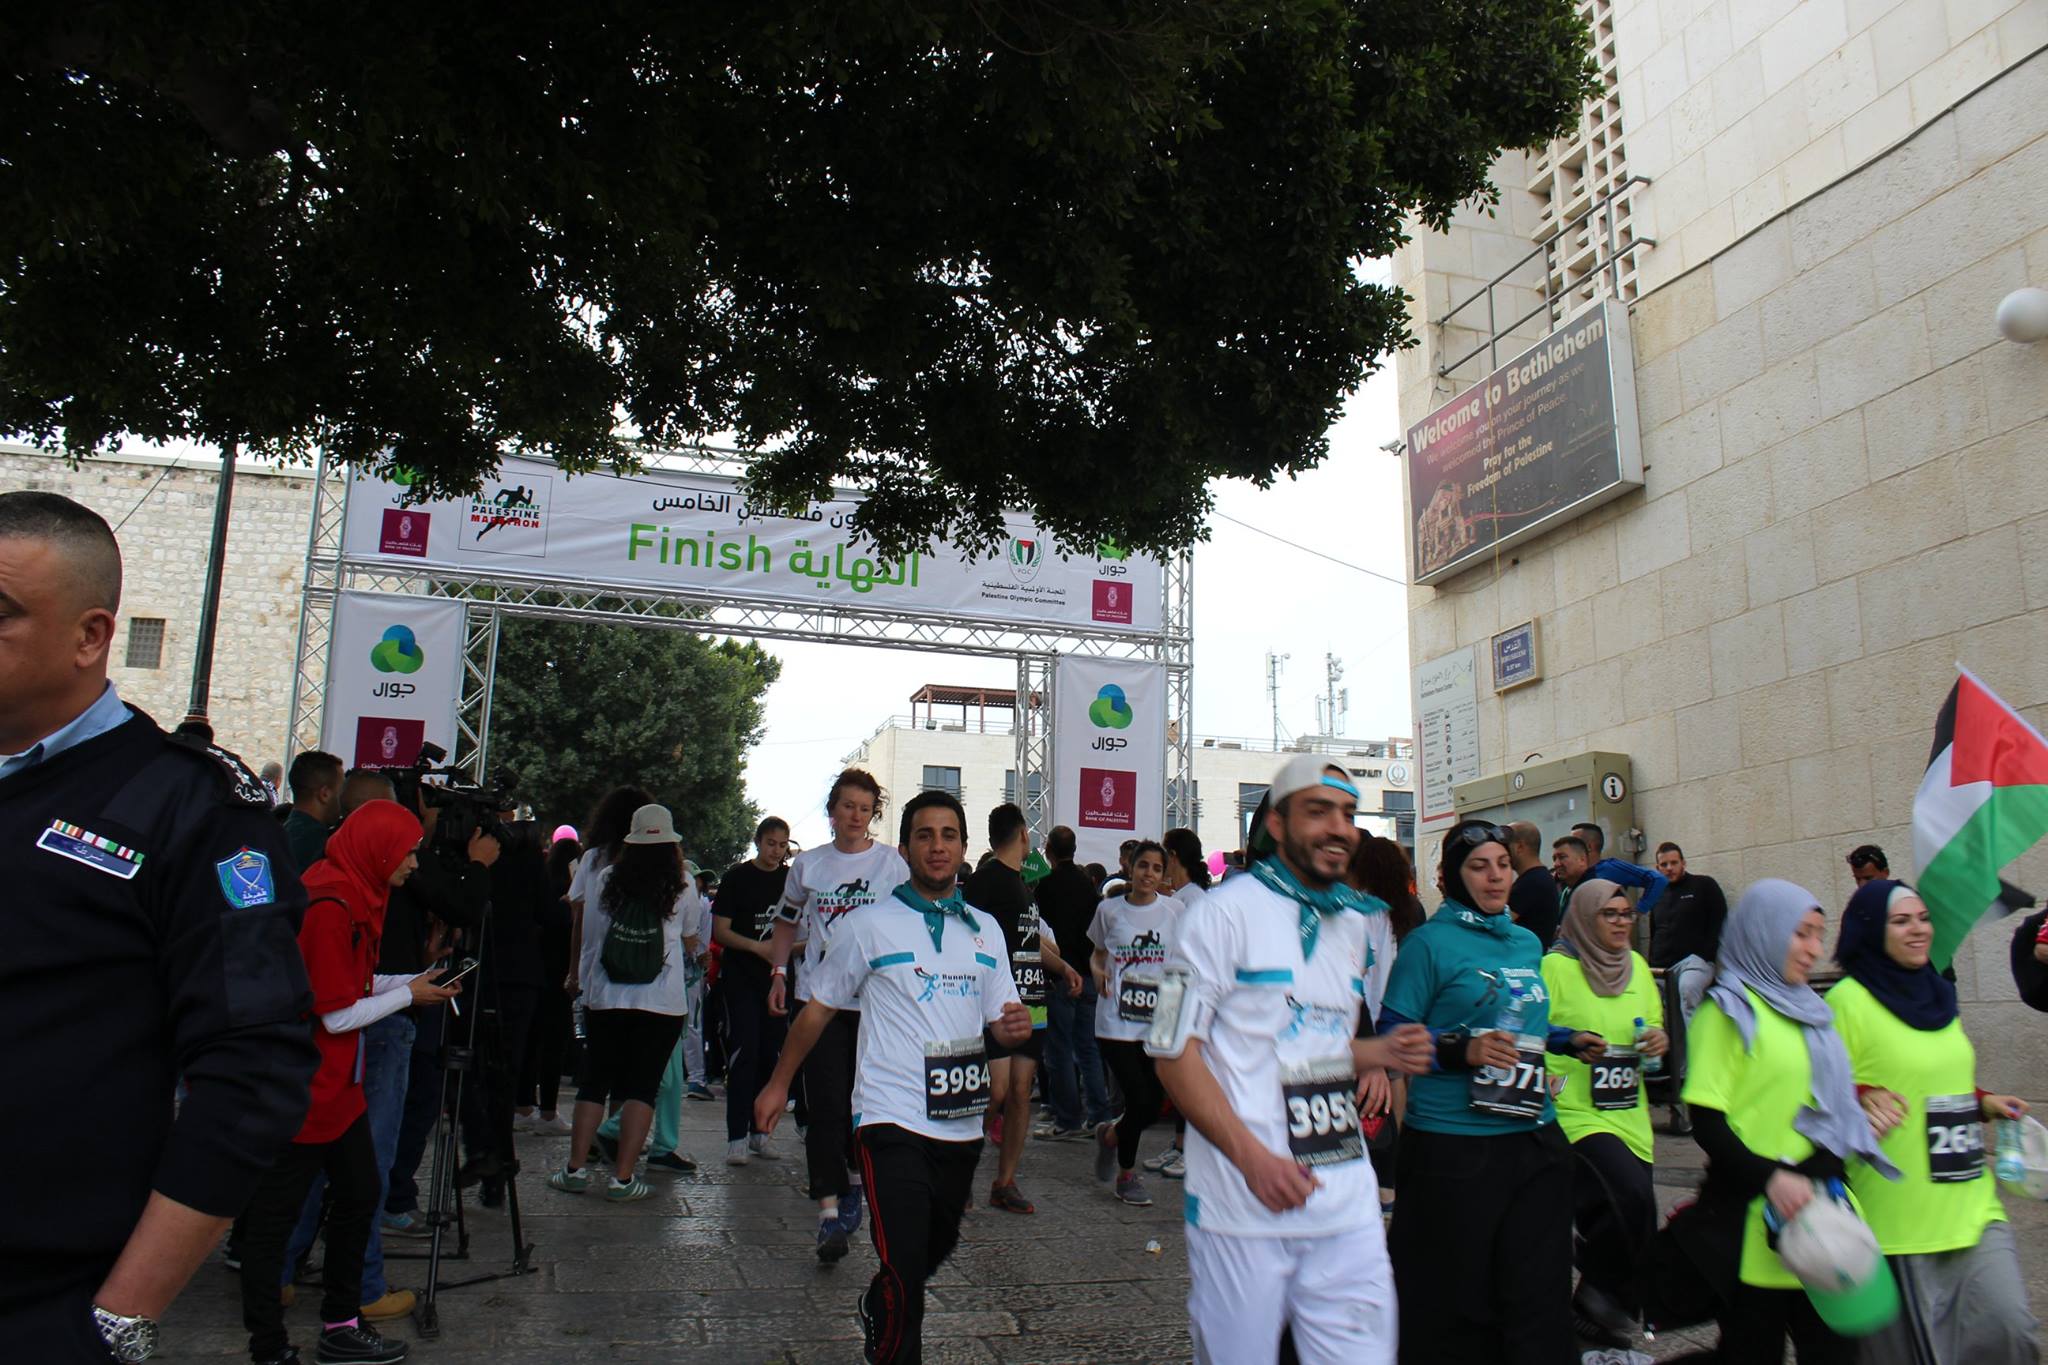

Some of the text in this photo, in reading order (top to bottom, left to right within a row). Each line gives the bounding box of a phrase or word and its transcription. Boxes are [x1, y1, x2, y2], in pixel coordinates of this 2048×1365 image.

[1412, 318, 1604, 454] Welcome to Bethlehem
[1503, 400, 1522, 423] your
[1523, 380, 1557, 410] journey
[1558, 371, 1570, 385] as
[1571, 362, 1585, 377] we
[1497, 417, 1525, 439] Prince
[1526, 408, 1536, 423] of
[1483, 435, 1532, 471] Pray for the
[1467, 470, 1501, 498] Freedom
[1503, 461, 1512, 476] of
[1514, 441, 1553, 470] Palestine
[472, 505, 540, 519] PALESTINE
[652, 492, 731, 513] الخامس
[628, 523, 772, 573] Finish
[1098, 564, 1127, 577] جوال
[981, 592, 1066, 605] Palestine Olympic Committee
[372, 682, 416, 698] جوال
[1092, 736, 1128, 751] جوال
[930, 1062, 991, 1096] 3984
